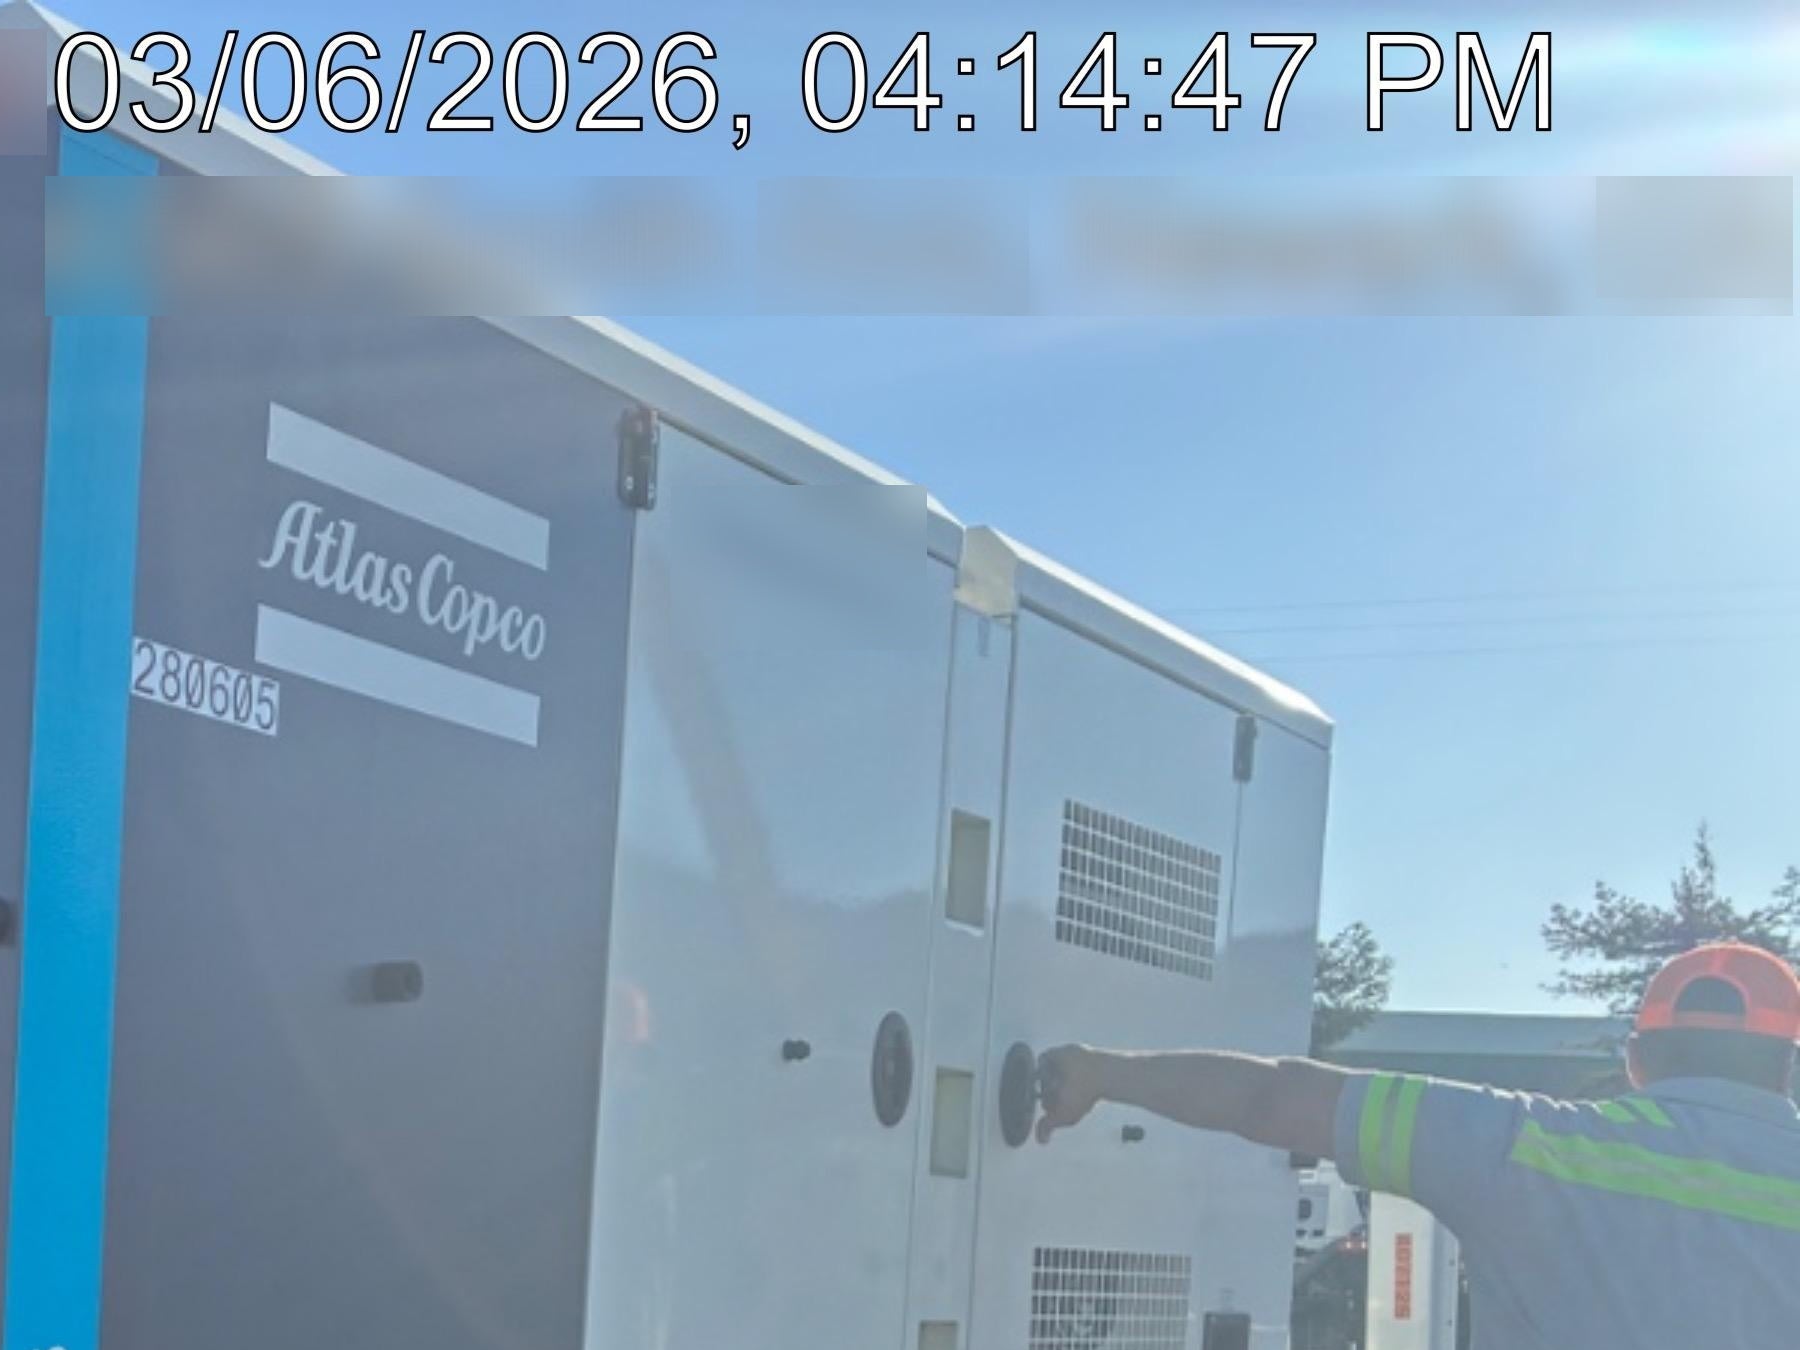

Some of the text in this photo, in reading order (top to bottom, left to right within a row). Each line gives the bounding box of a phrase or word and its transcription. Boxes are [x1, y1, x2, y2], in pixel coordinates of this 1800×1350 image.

[258, 499, 547, 662] Atlas Copco
[134, 641, 277, 732] 280605
